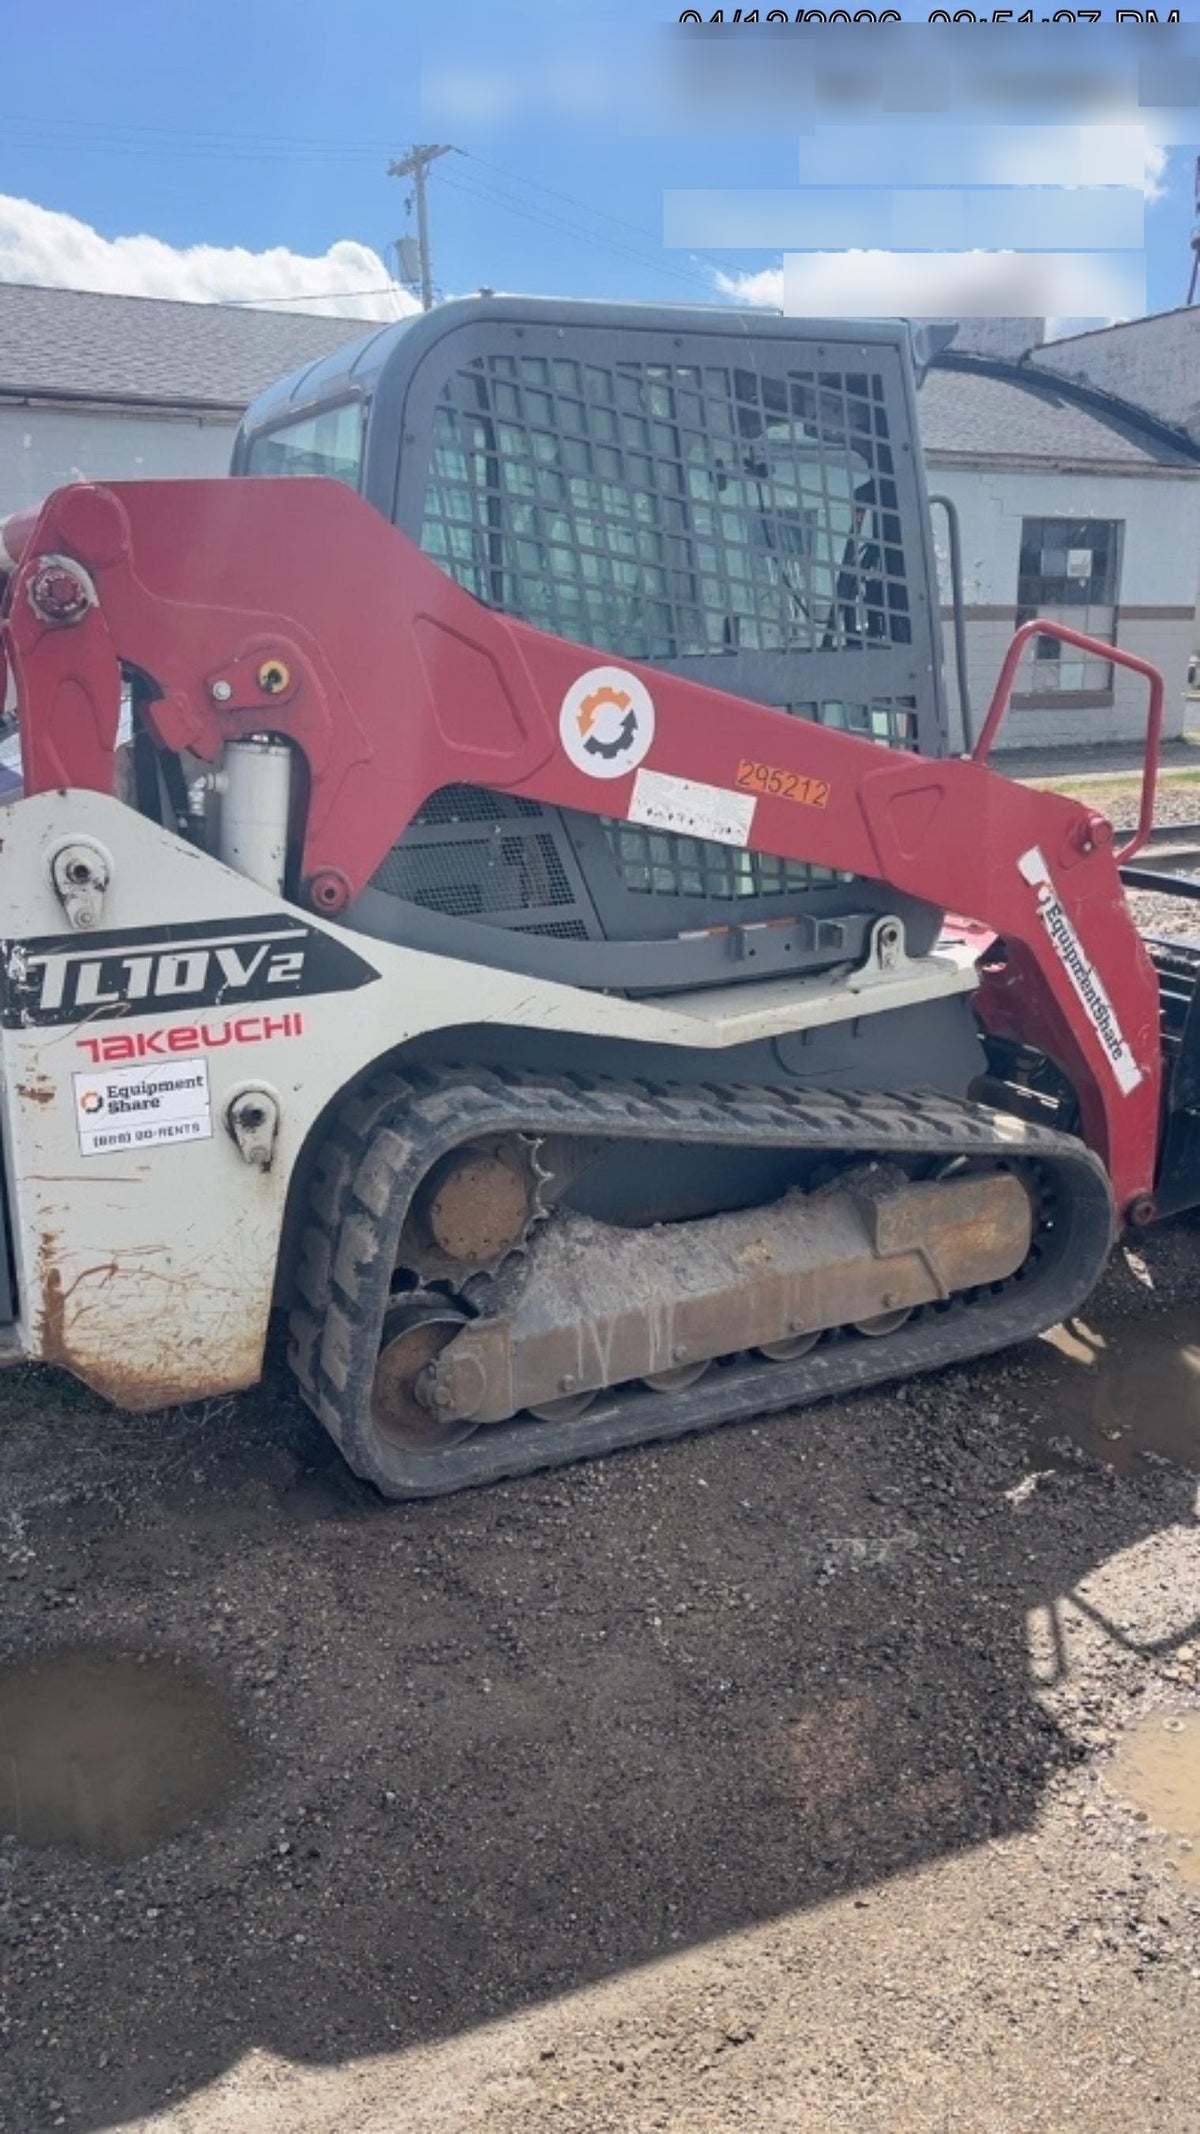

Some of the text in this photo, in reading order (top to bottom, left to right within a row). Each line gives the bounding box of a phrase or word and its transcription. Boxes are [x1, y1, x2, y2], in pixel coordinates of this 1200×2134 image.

[738, 763, 828, 807] 295212
[27, 943, 305, 1009] TL10V2
[1045, 902, 1123, 1061] EquipmentShare
[106, 1075, 204, 1099] Equipment
[108, 1096, 161, 1114] Share
